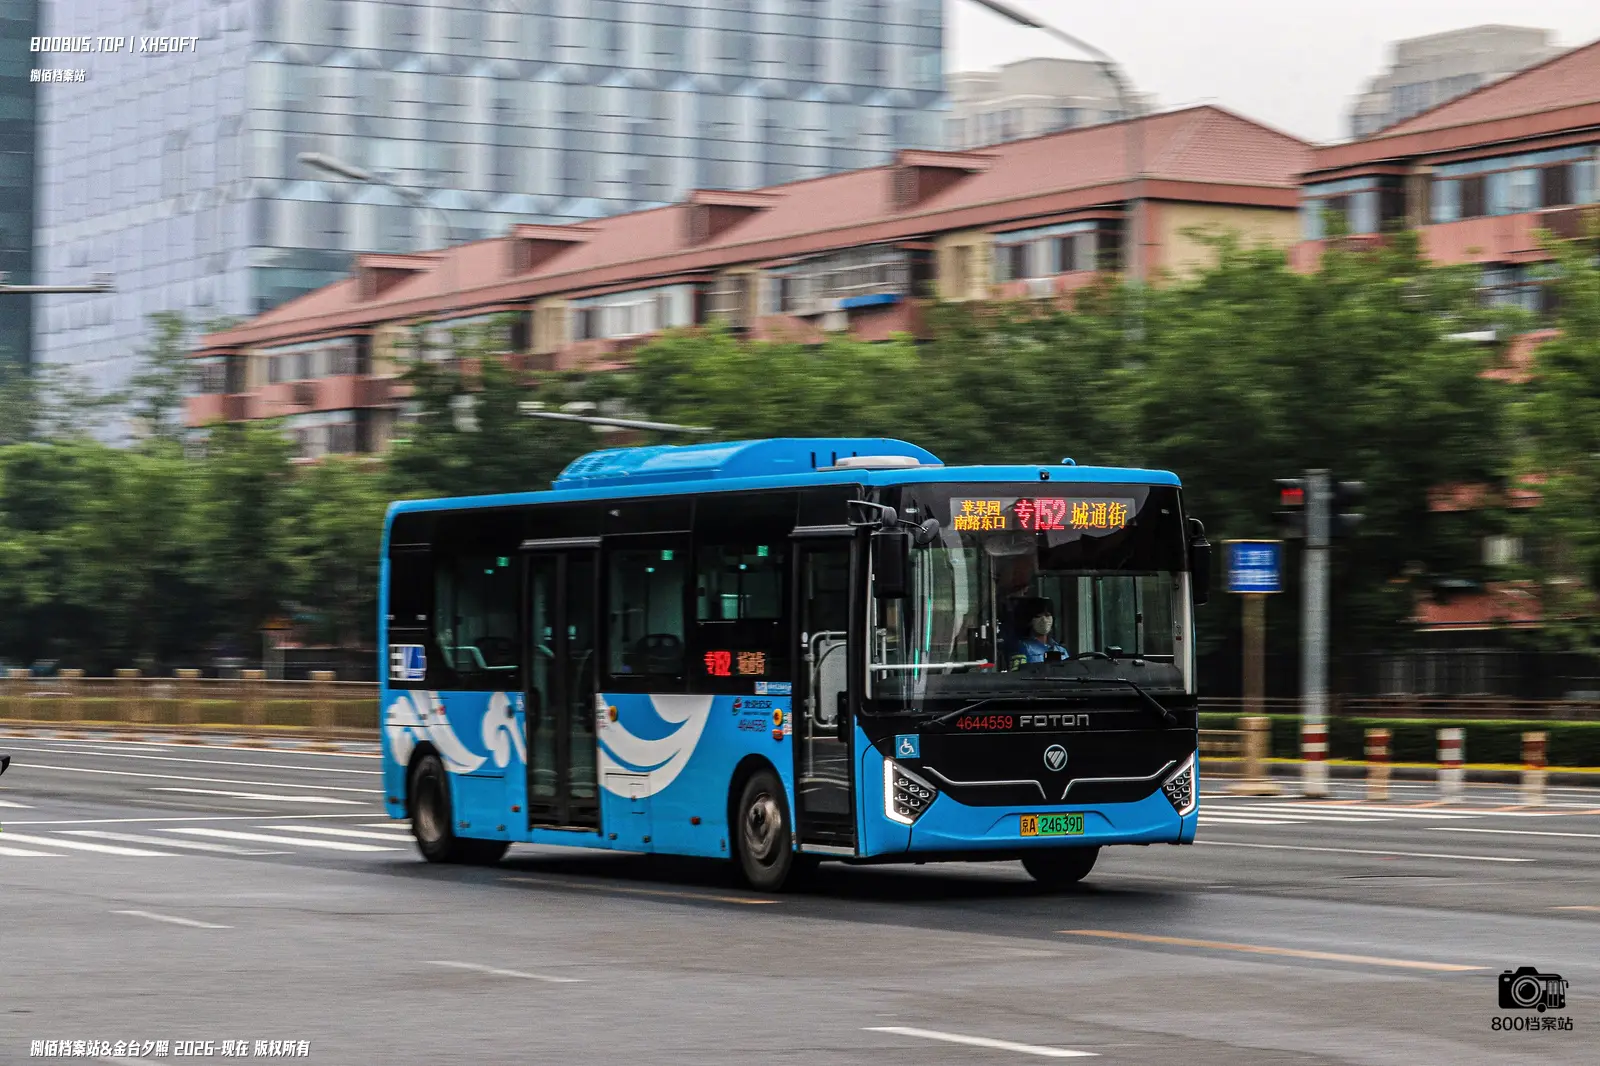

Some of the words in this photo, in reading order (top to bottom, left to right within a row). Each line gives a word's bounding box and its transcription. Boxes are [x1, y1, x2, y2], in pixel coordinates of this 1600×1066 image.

[961, 500, 1001, 516] 苹果园
[1070, 501, 1128, 530] 城通街
[953, 515, 1006, 531] 南路东口
[956, 715, 1013, 730] 4644559
[1019, 714, 1090, 728] FOTON
[1041, 816, 1083, 833] 24639D
